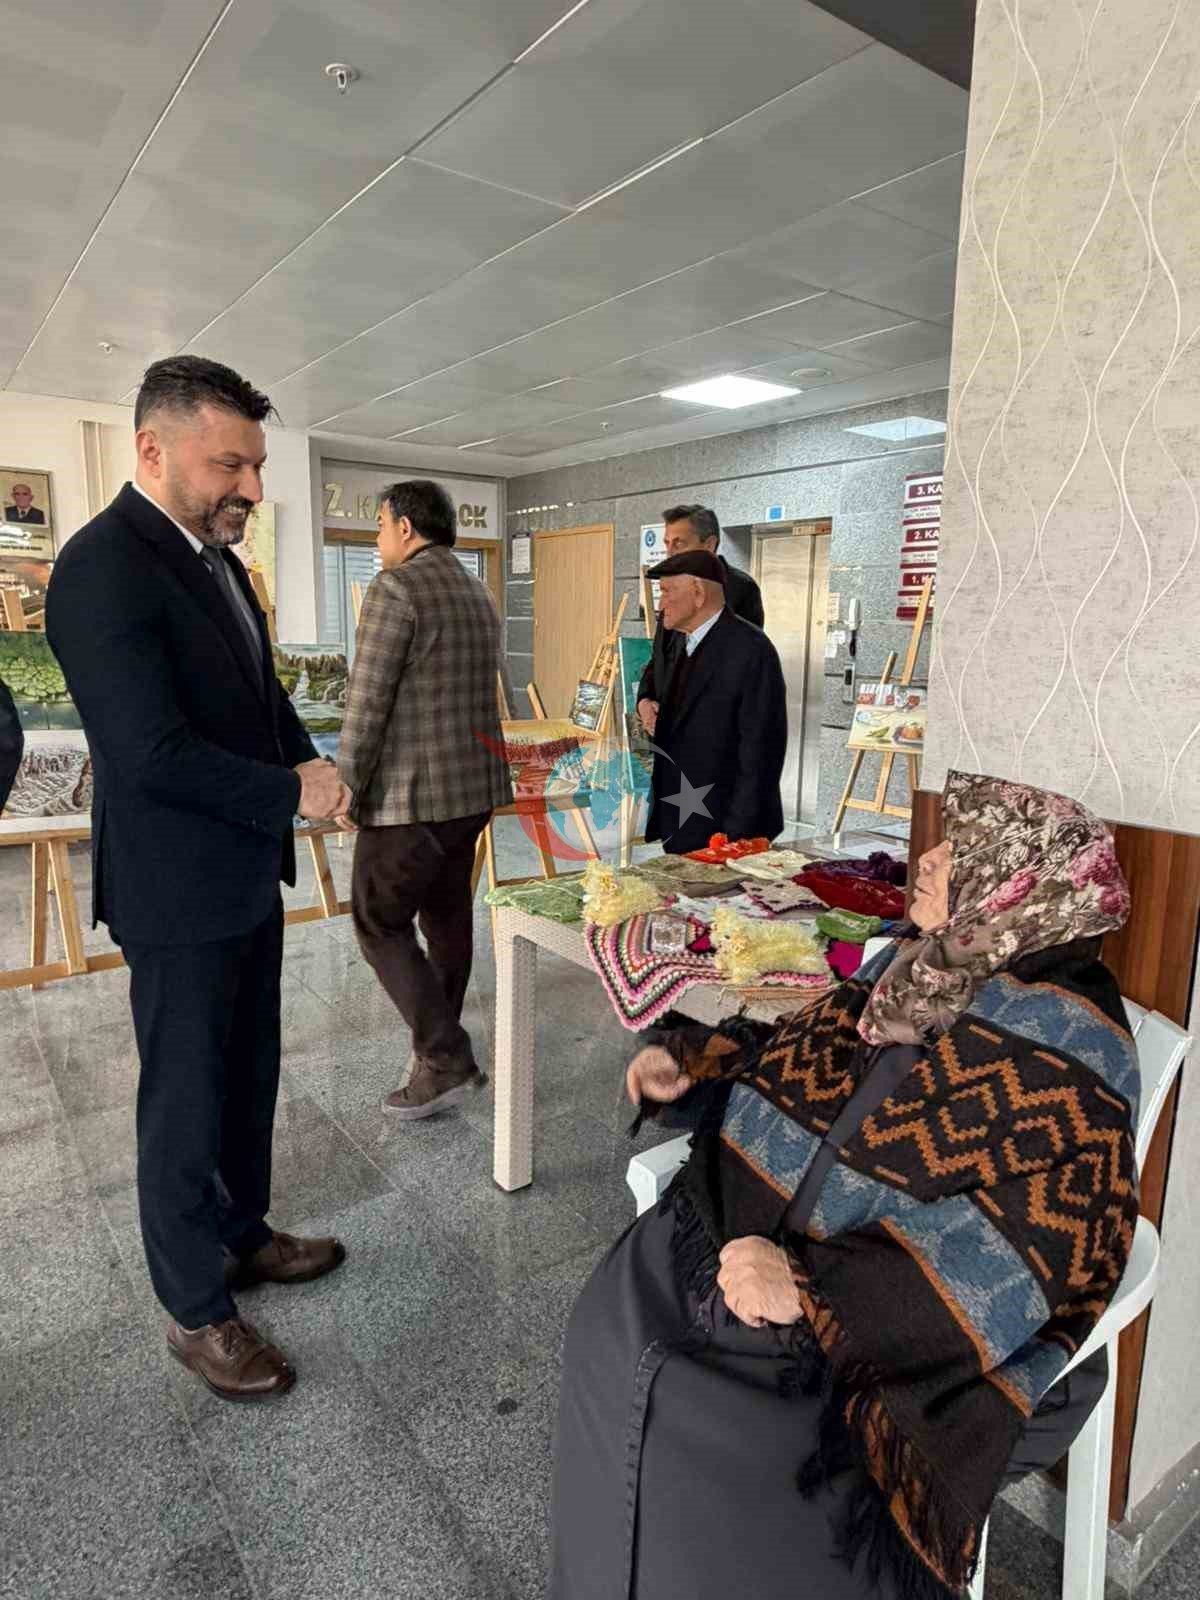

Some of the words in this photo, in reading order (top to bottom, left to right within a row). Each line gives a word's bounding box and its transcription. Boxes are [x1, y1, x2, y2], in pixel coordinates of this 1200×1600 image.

[928, 483, 943, 494] KA
[456, 503, 488, 528] OK
[925, 529, 940, 539] KA
